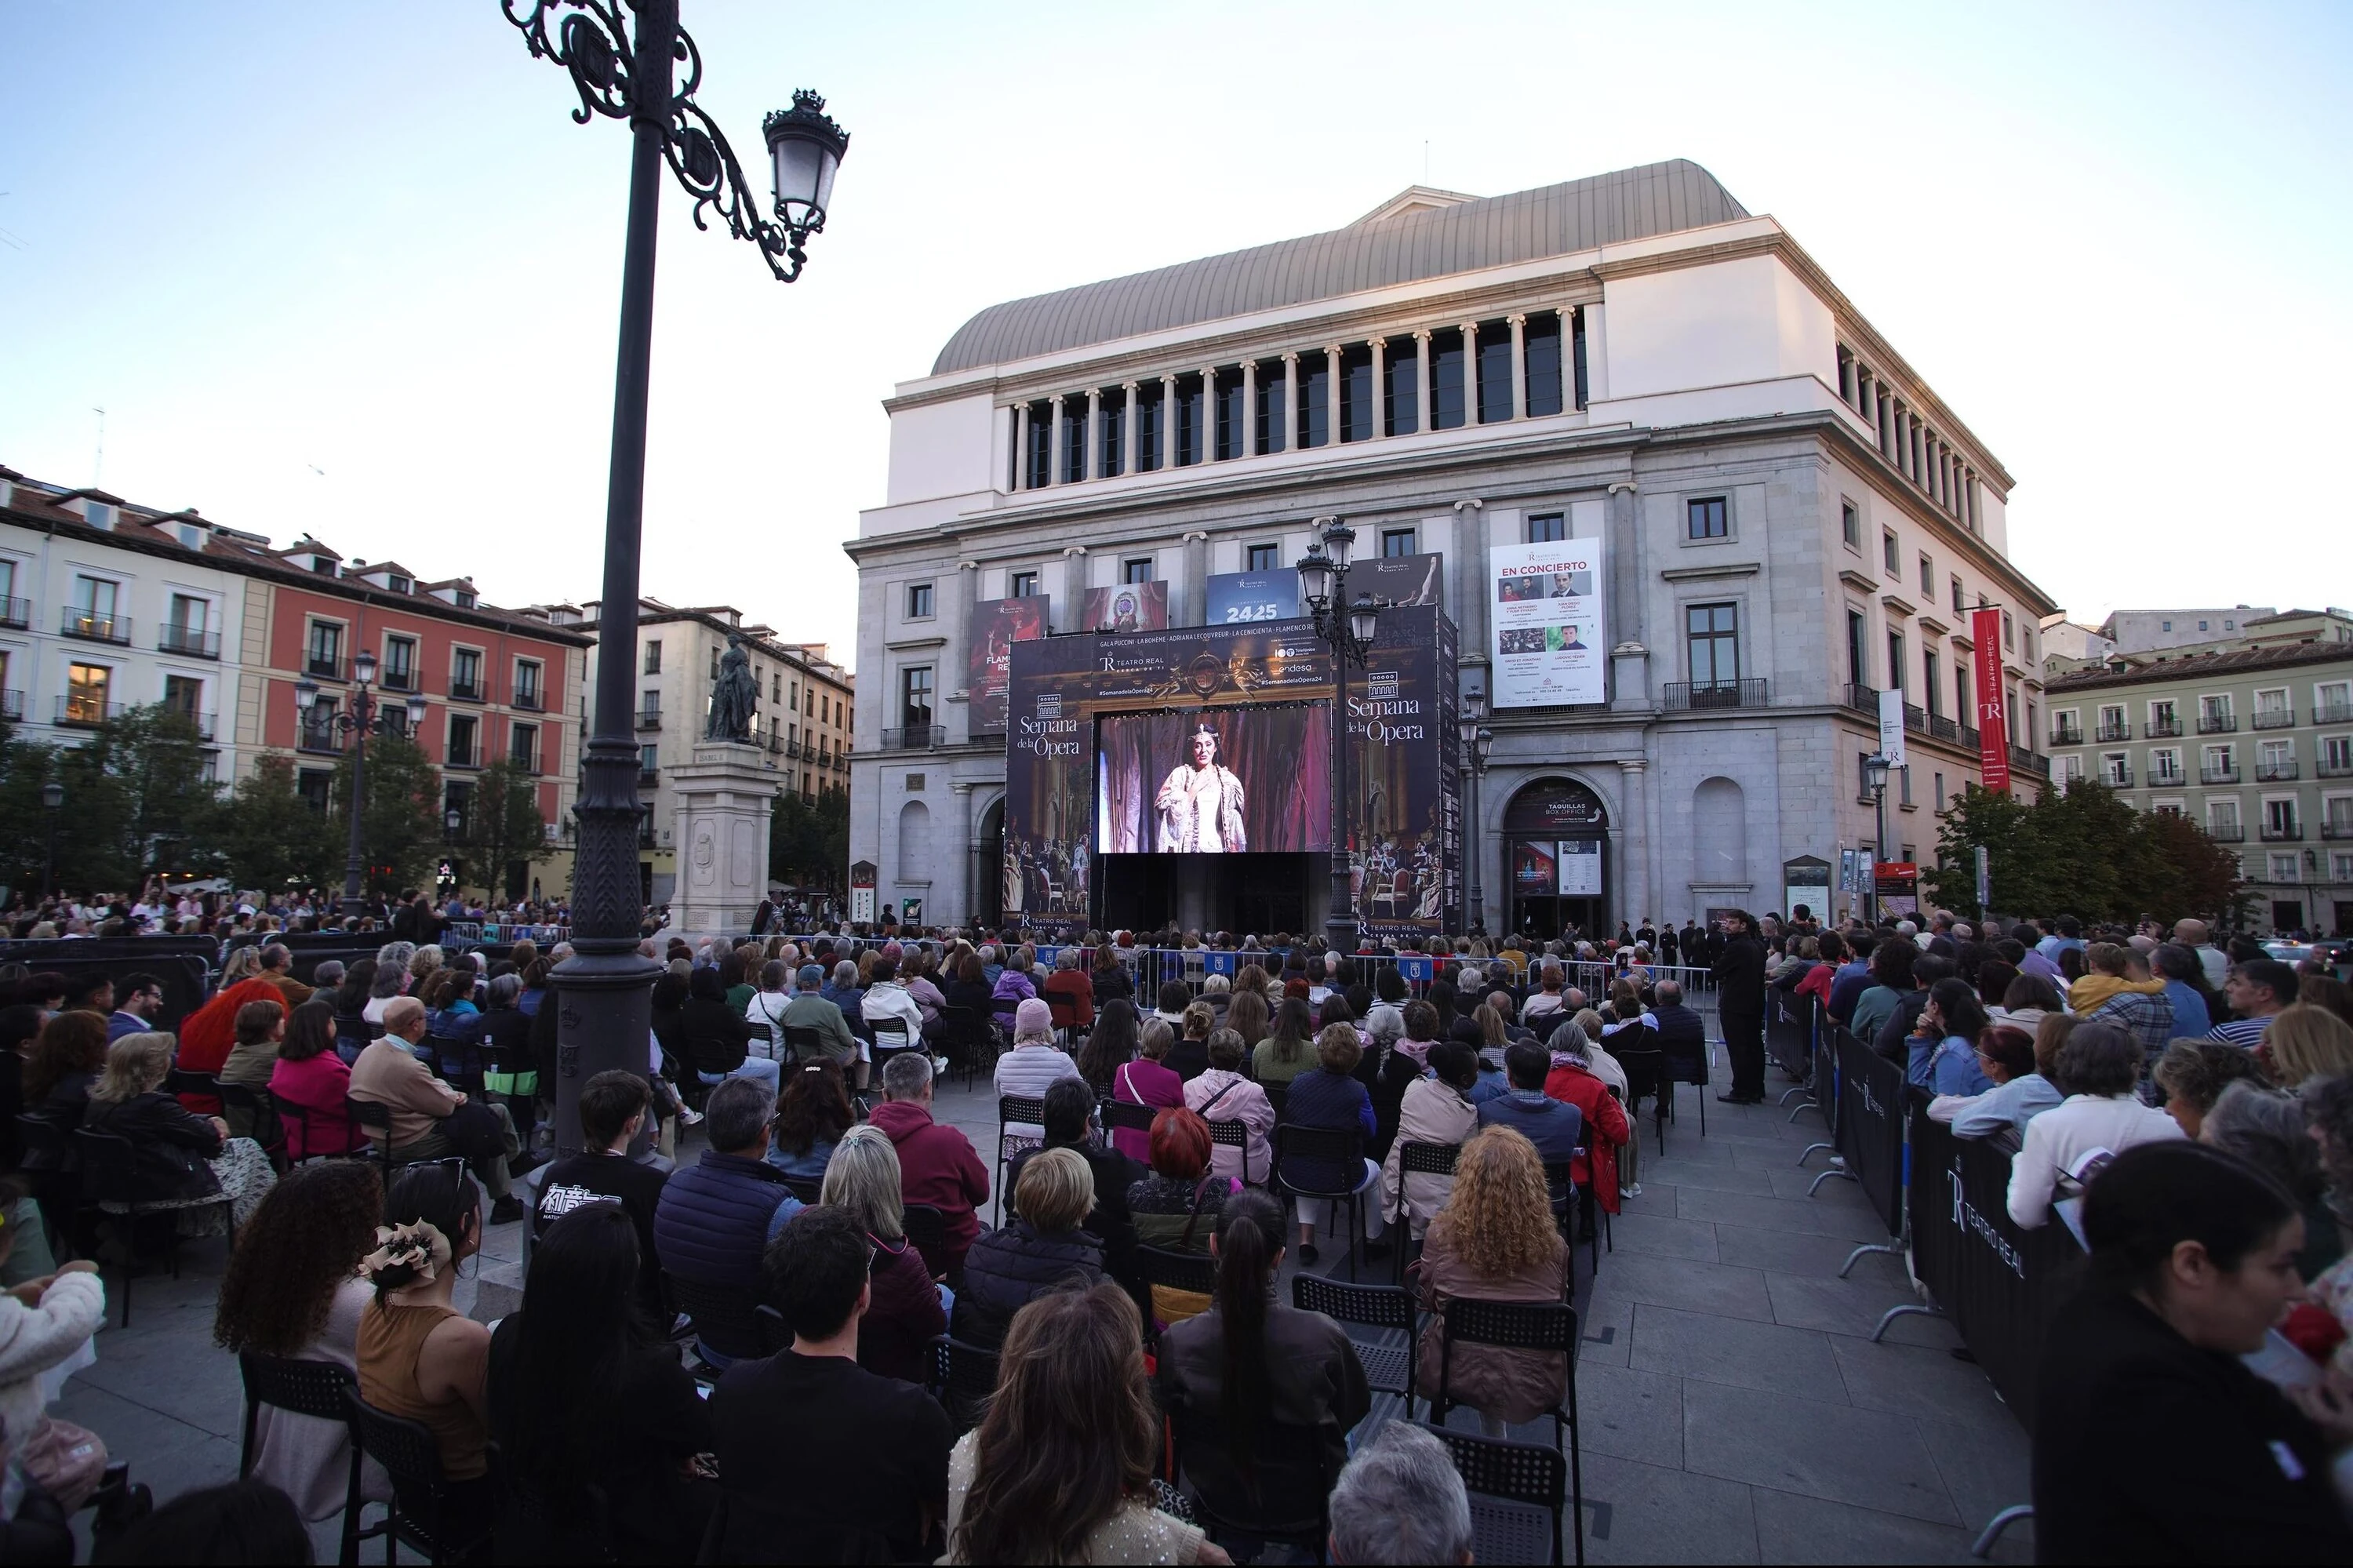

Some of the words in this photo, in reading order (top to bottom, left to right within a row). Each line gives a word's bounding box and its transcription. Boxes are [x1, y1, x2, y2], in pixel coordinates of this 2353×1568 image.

[1502, 568, 1517, 576] EN
[1520, 561, 1587, 575] CONCIERTO
[1145, 635, 1166, 644] BOHÈME
[1194, 631, 1229, 639] LECOUVREUR
[1240, 627, 1272, 635] CENICIENTA
[987, 656, 1009, 664] FLAM
[1279, 664, 1312, 673] endesa
[1261, 676, 1322, 686] #SemanadelaÓpera24
[1988, 658, 1997, 692] TEATRO
[1099, 687, 1153, 696] #SemanadelaÓpera24
[1347, 696, 1420, 717] Semana
[1020, 716, 1077, 735] Semana
[1358, 721, 1365, 733] la
[1366, 716, 1424, 746] Ópera
[1017, 738, 1026, 748] de
[1027, 738, 1034, 748] la
[1034, 733, 1080, 760] Ópera
[1965, 1202, 1997, 1249] TEATRO
[1999, 1236, 2026, 1280] REAL
